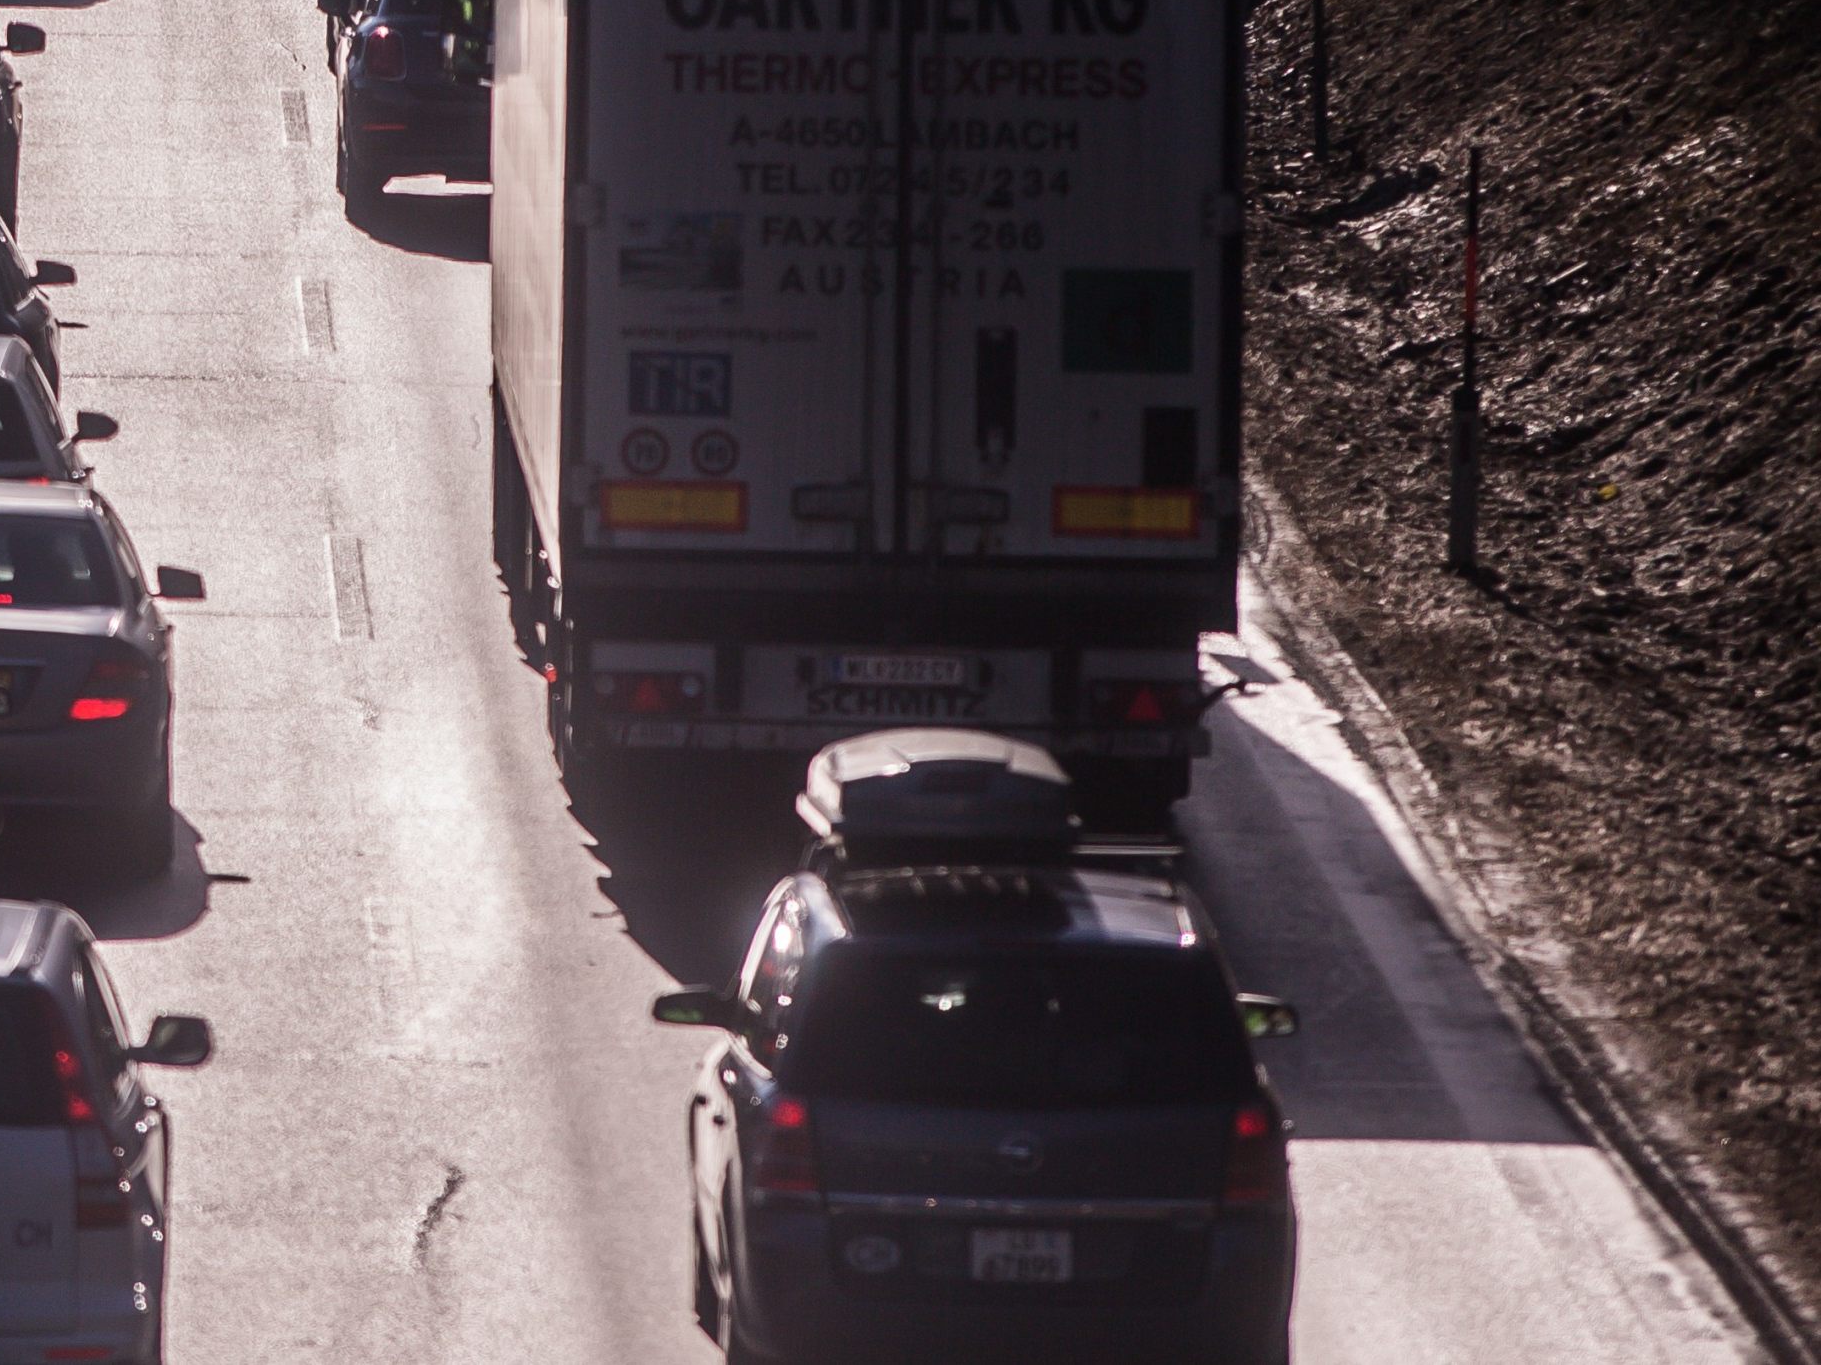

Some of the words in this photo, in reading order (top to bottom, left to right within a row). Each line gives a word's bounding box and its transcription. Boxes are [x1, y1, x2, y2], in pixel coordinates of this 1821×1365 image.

[665, 52, 874, 96] THERMO
[917, 56, 1150, 100] EXPRESS
[761, 217, 836, 247] FAX
[637, 356, 726, 413] TIR
[806, 686, 987, 718] SCHMITZ
